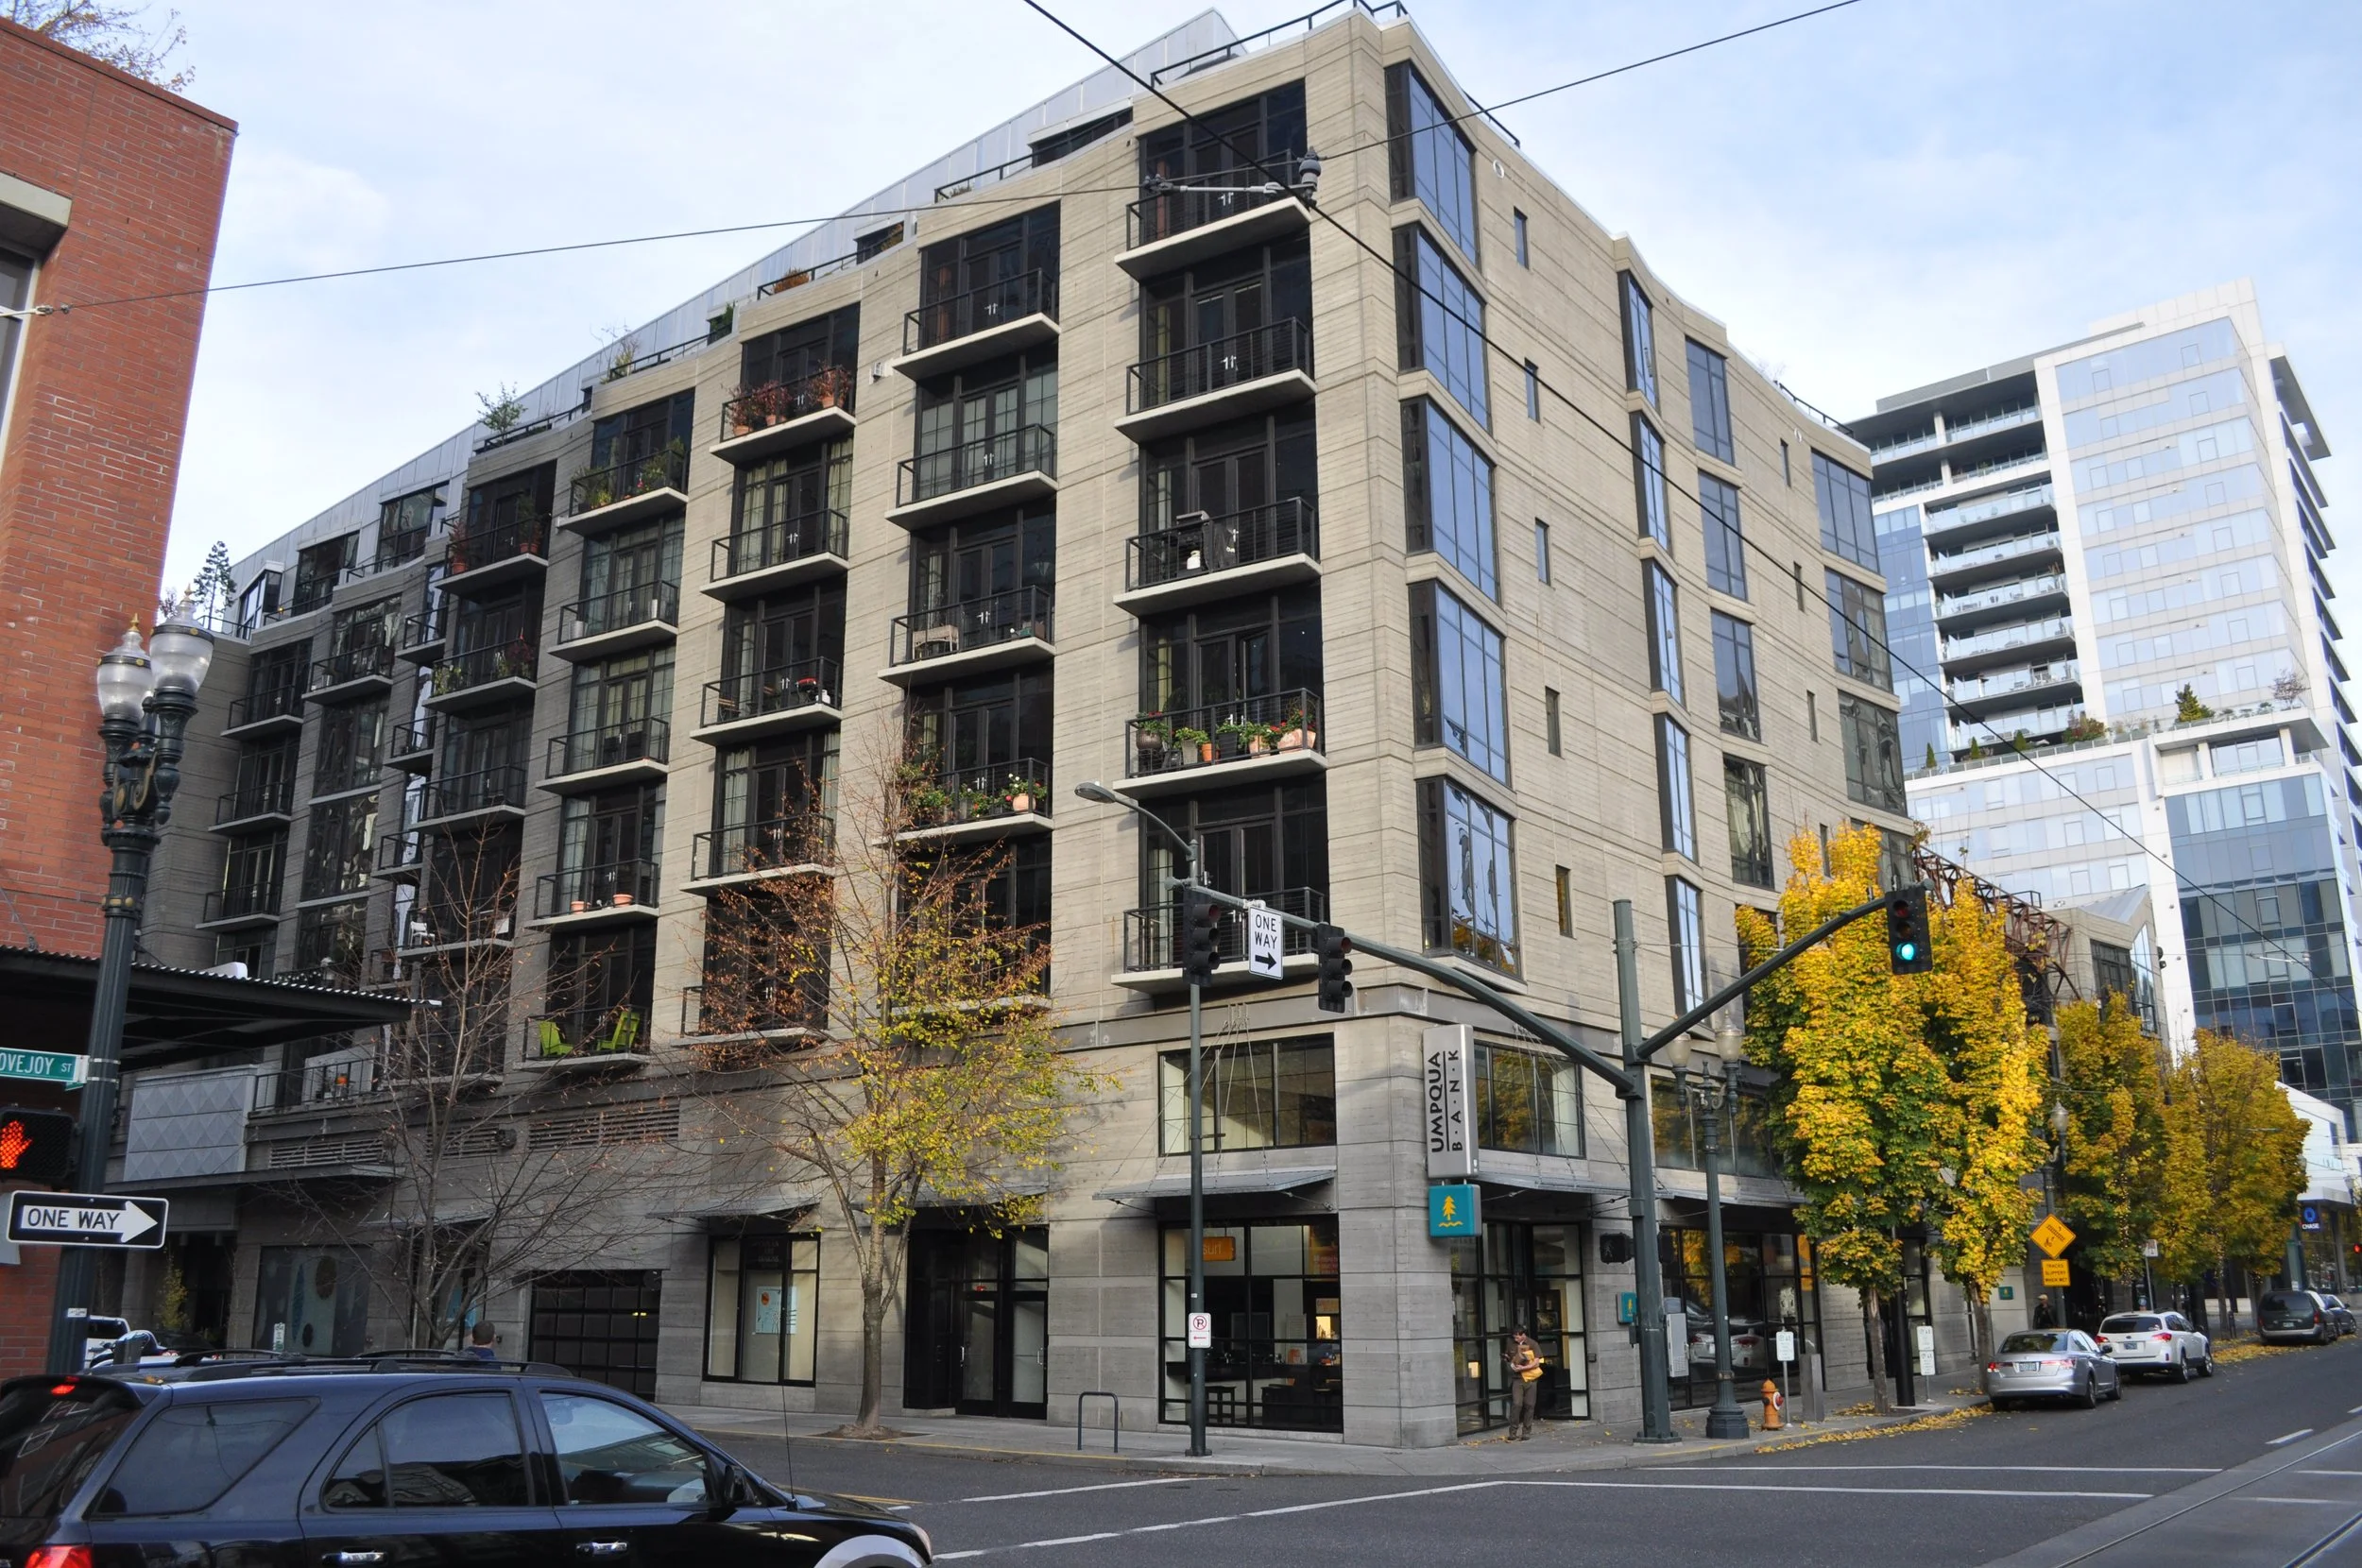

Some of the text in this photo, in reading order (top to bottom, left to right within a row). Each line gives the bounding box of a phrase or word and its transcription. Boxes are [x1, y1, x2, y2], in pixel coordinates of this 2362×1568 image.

[1255, 913, 1276, 932] ONE
[1255, 930, 1277, 949] WAY
[60, 1063, 73, 1073] ST
[1428, 1051, 1444, 1152] UMPQUA
[27, 1208, 121, 1230] ONE WAY
